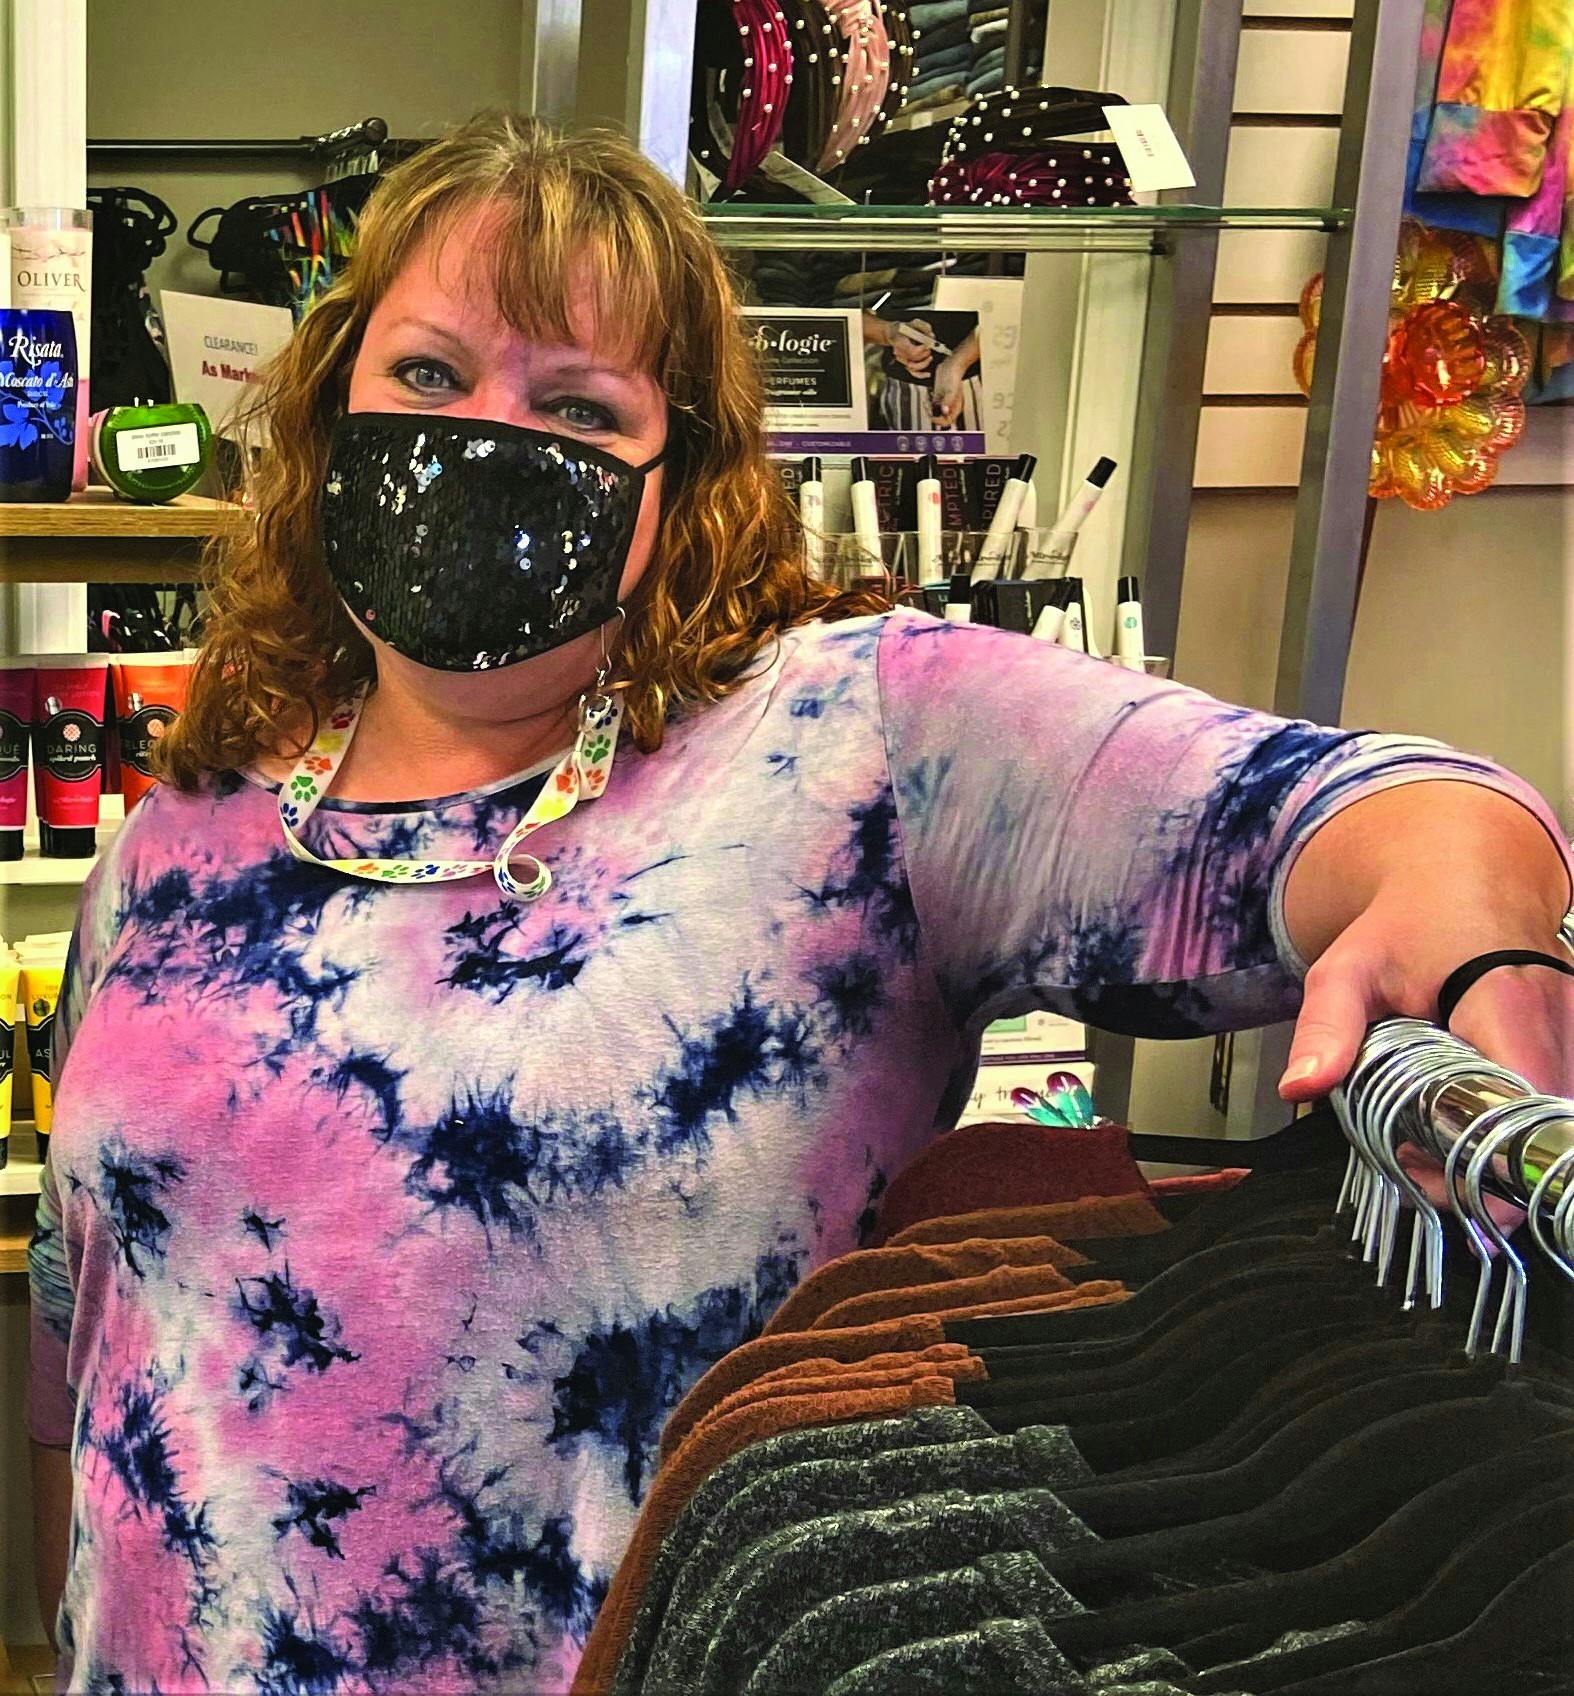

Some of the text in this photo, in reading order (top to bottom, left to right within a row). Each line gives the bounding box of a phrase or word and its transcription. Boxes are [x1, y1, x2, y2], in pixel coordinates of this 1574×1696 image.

[18, 270, 86, 292] OLIVER
[9, 336, 62, 369] Risata
[202, 360, 218, 377] As
[767, 377, 817, 386] ERFUMES
[47, 743, 97, 754] DARING
